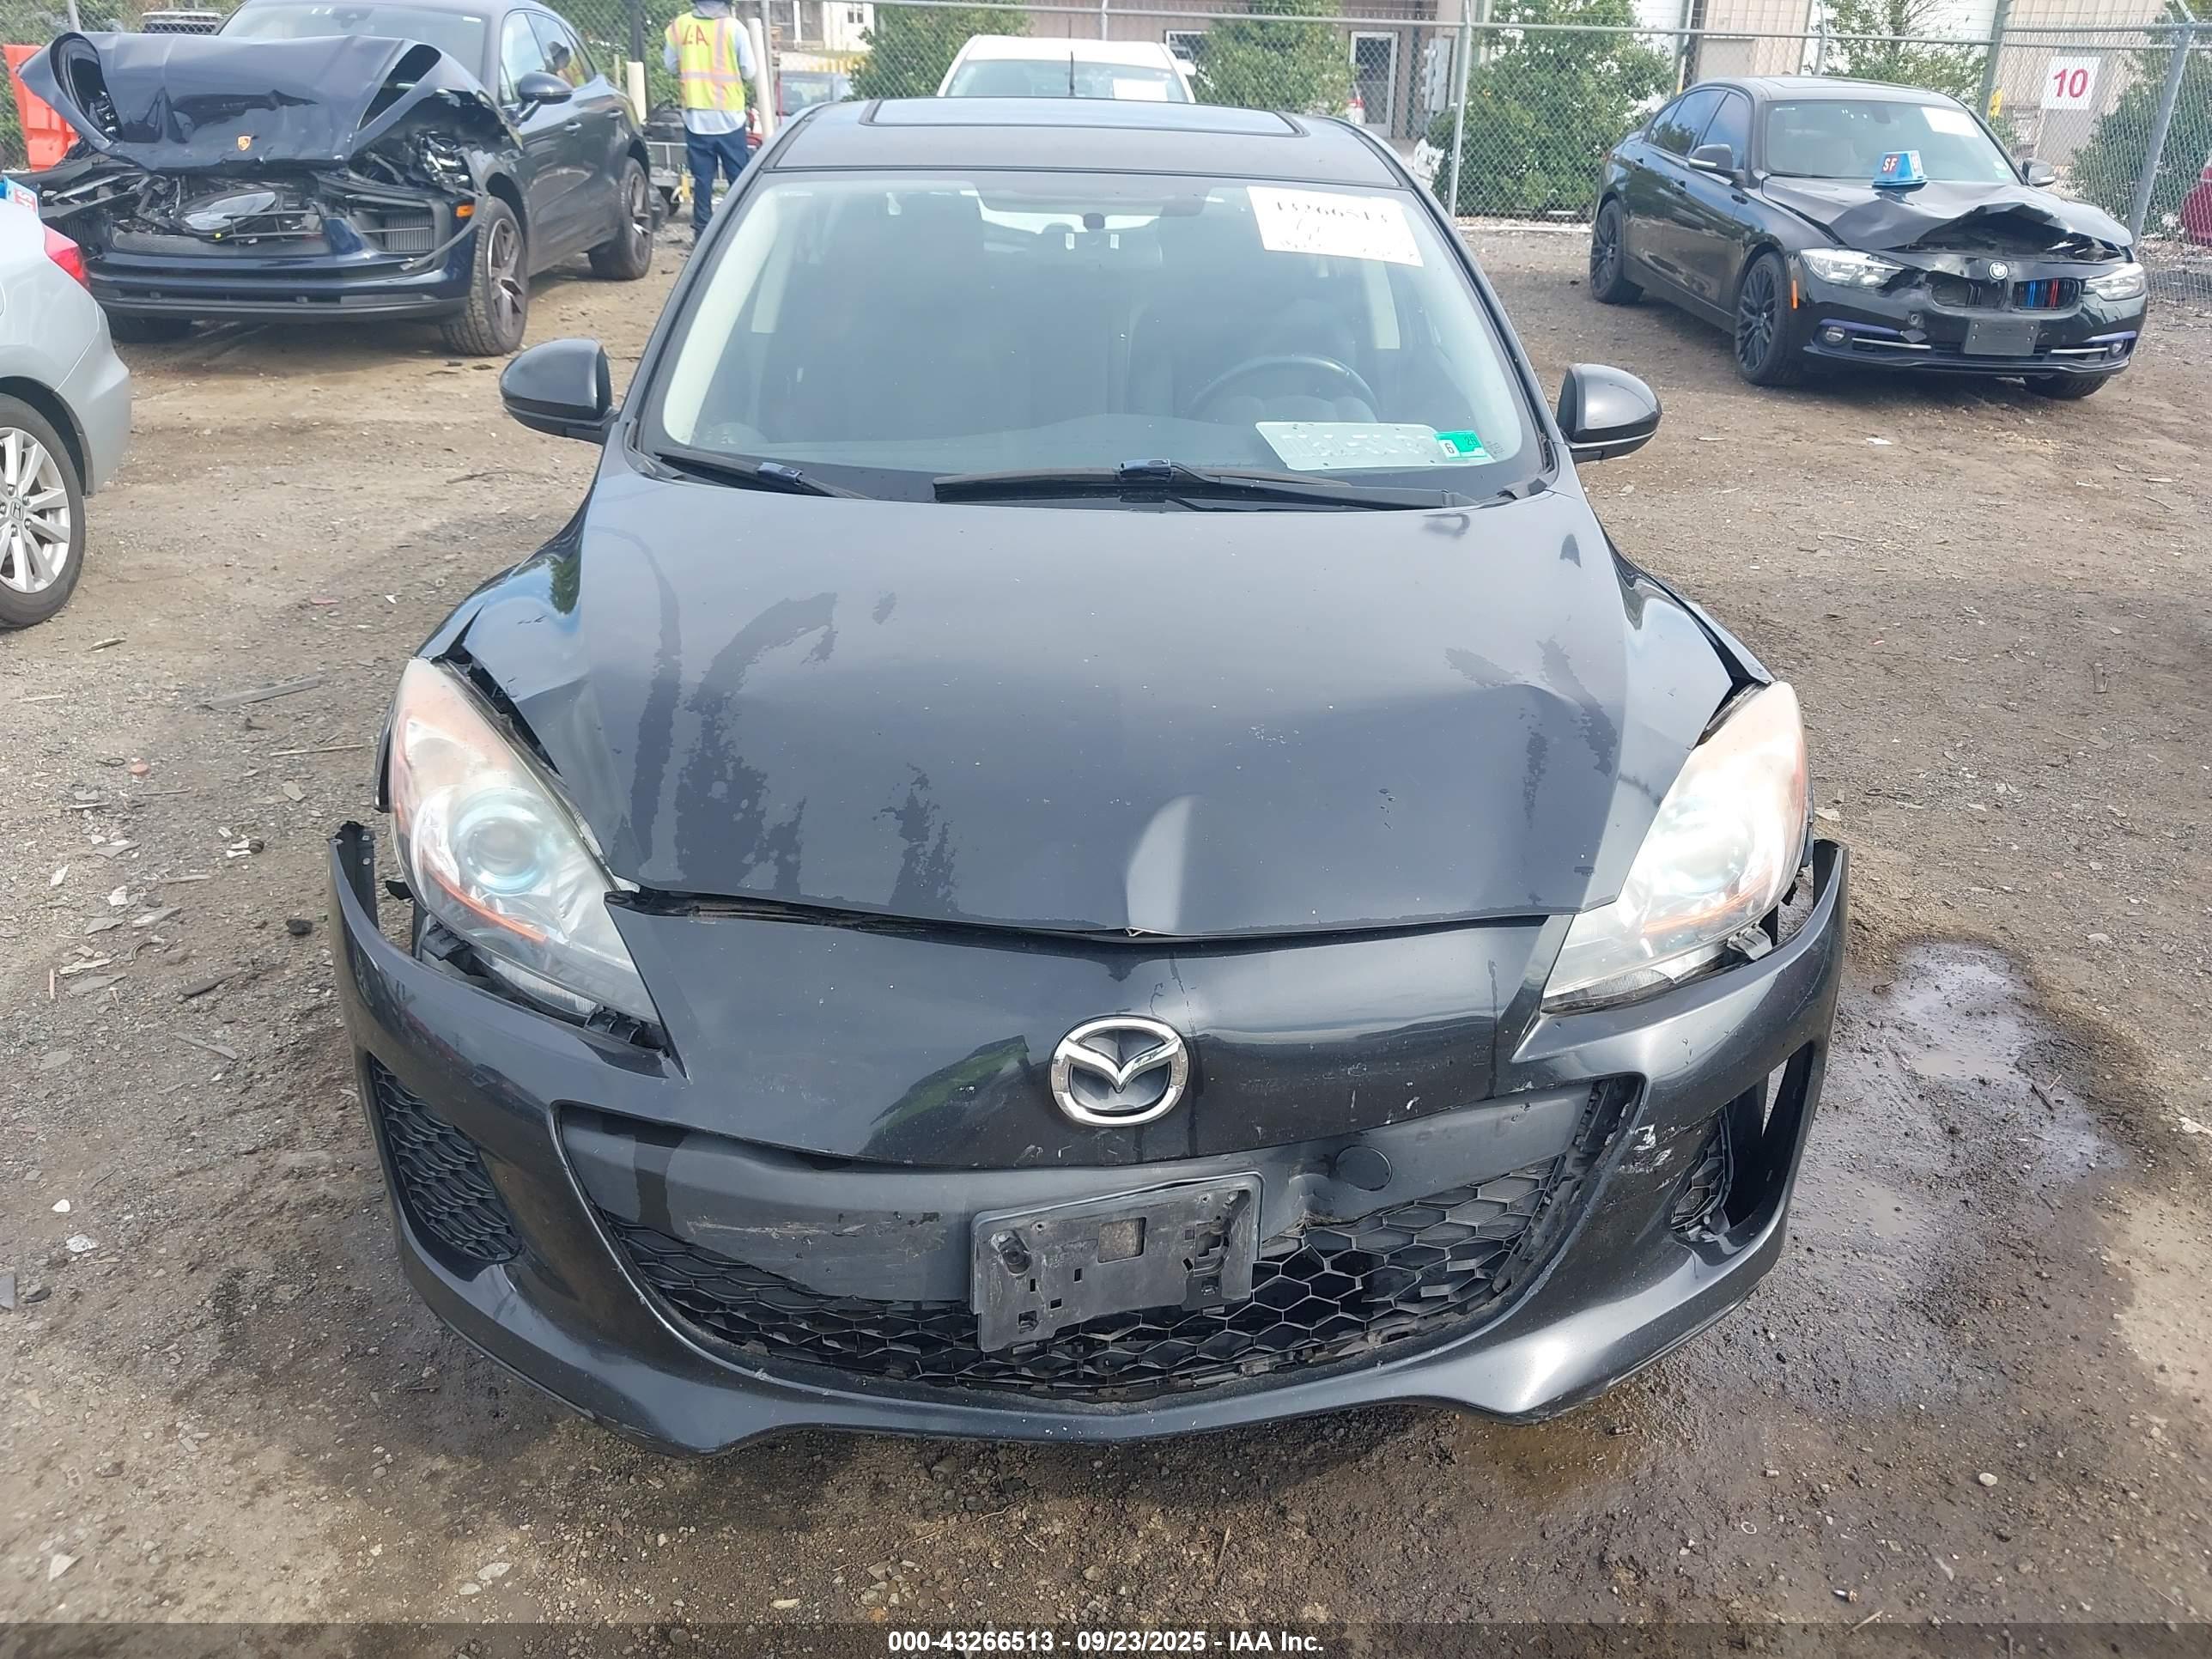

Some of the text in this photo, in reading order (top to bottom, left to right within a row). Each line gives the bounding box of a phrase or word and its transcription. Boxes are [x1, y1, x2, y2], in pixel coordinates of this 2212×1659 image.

[2053, 69, 2088, 98] 10
[1882, 157, 1898, 172] SF
[1444, 442, 1455, 454] 6
